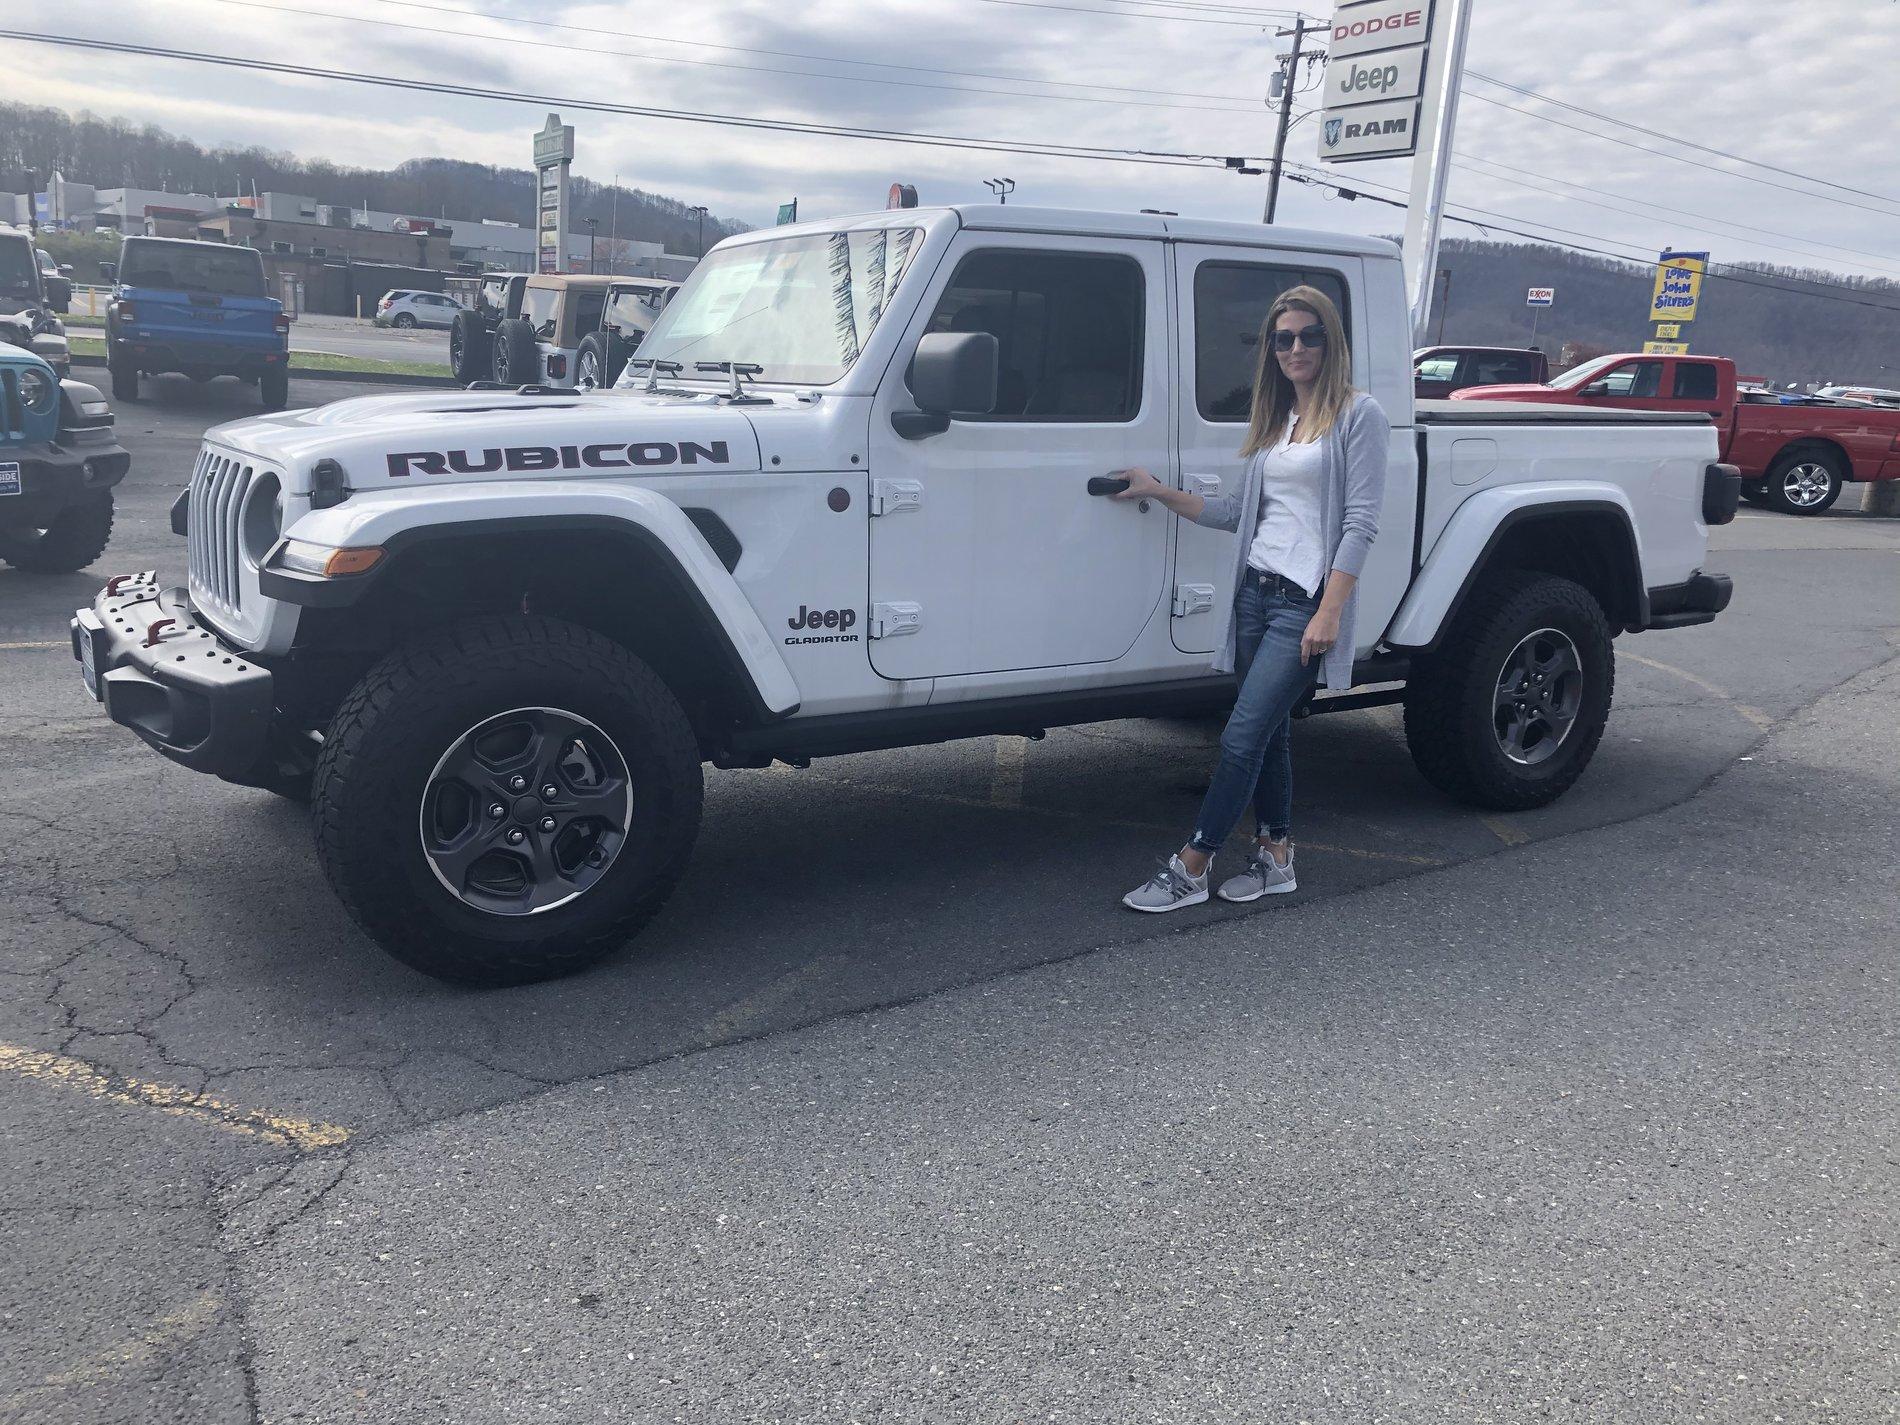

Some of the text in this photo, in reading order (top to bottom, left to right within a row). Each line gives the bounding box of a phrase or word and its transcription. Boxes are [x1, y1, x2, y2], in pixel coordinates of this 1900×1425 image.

[1334, 10, 1421, 41] DODGE
[1340, 64, 1399, 93] Jeep
[1345, 118, 1407, 138] RAM
[1530, 290, 1551, 299] EXXON
[386, 441, 730, 477] RUBICON
[788, 605, 856, 632] Jeep
[784, 635, 859, 645] GLADIATOR
